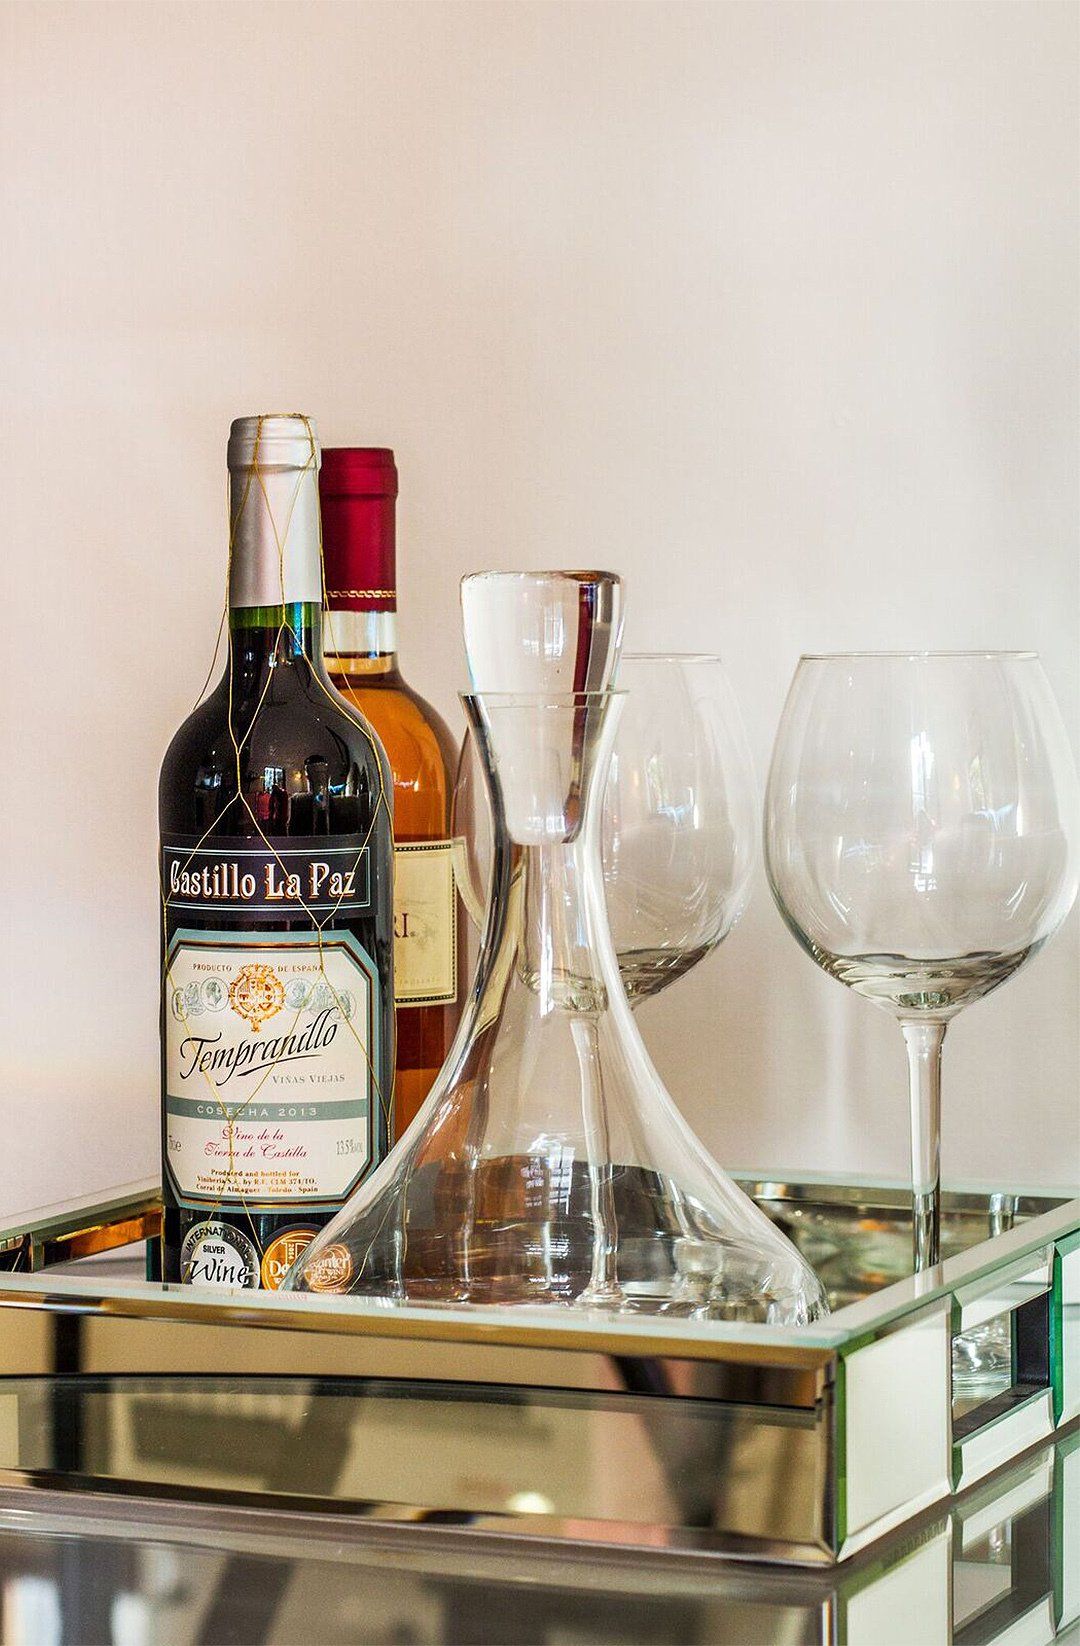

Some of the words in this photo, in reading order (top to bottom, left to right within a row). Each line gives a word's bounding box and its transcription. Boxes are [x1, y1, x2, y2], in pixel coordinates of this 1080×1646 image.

[170, 860, 256, 898] Castillo
[264, 862, 303, 900] La
[309, 862, 357, 899] Paz
[192, 963, 233, 973] PRODUCTO
[277, 964, 290, 973] DE
[179, 1006, 339, 1086] Tempranillo
[196, 1104, 270, 1118] COSECHA
[278, 1107, 318, 1117] 2013
[222, 1126, 254, 1141] Vino
[257, 1128, 273, 1141] de
[274, 1128, 285, 1141] la
[203, 1142, 240, 1159] Tierra
[242, 1145, 257, 1158] de
[259, 1144, 309, 1160] Castilla
[245, 1169, 259, 1177] and
[288, 1169, 300, 1177] for
[299, 1186, 319, 1194] Spain
[186, 1225, 252, 1259] INTERNATIONAL
[202, 1244, 226, 1255] SILVER
[183, 1258, 254, 1285] Wine
